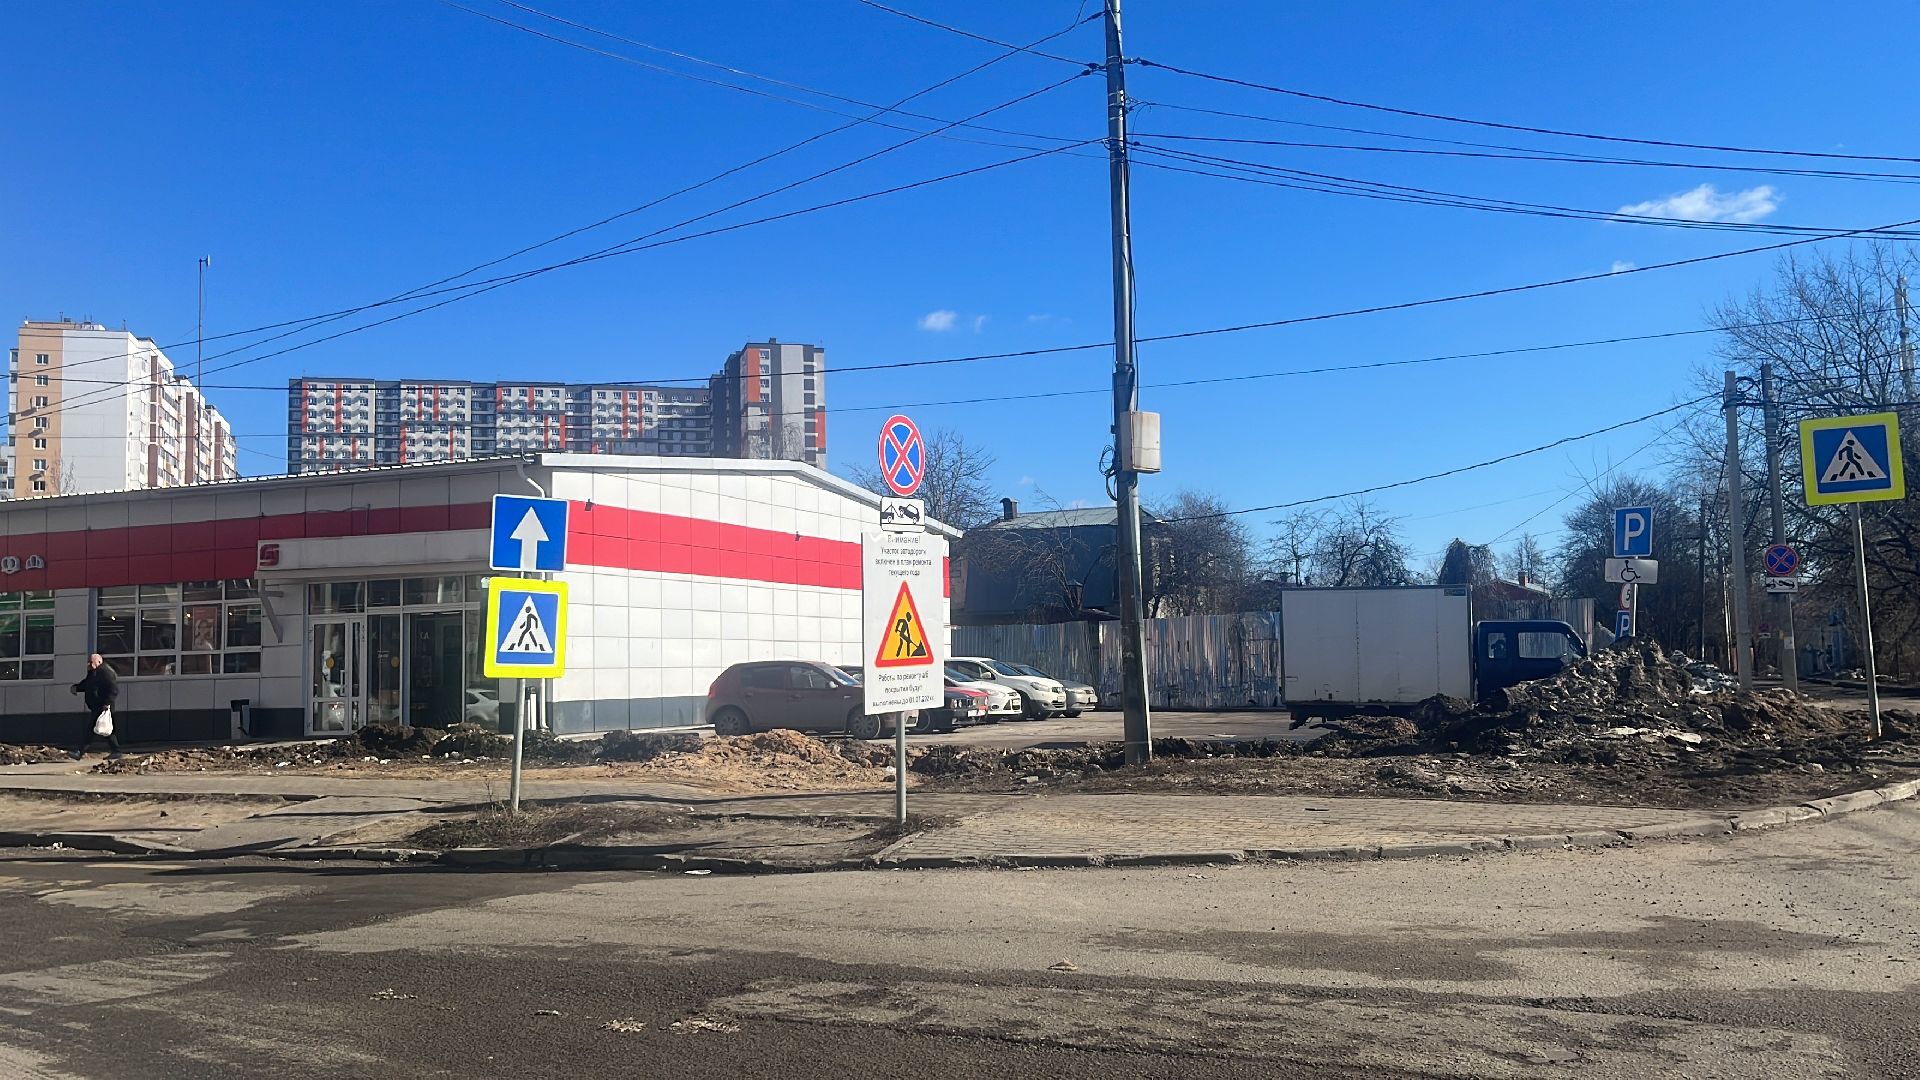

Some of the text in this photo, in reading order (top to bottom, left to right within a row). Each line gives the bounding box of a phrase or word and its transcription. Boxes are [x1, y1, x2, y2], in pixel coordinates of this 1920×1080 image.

[1624, 513, 1645, 550] P
[913, 559, 932, 567] ремонта
[1620, 615, 1629, 637] P
